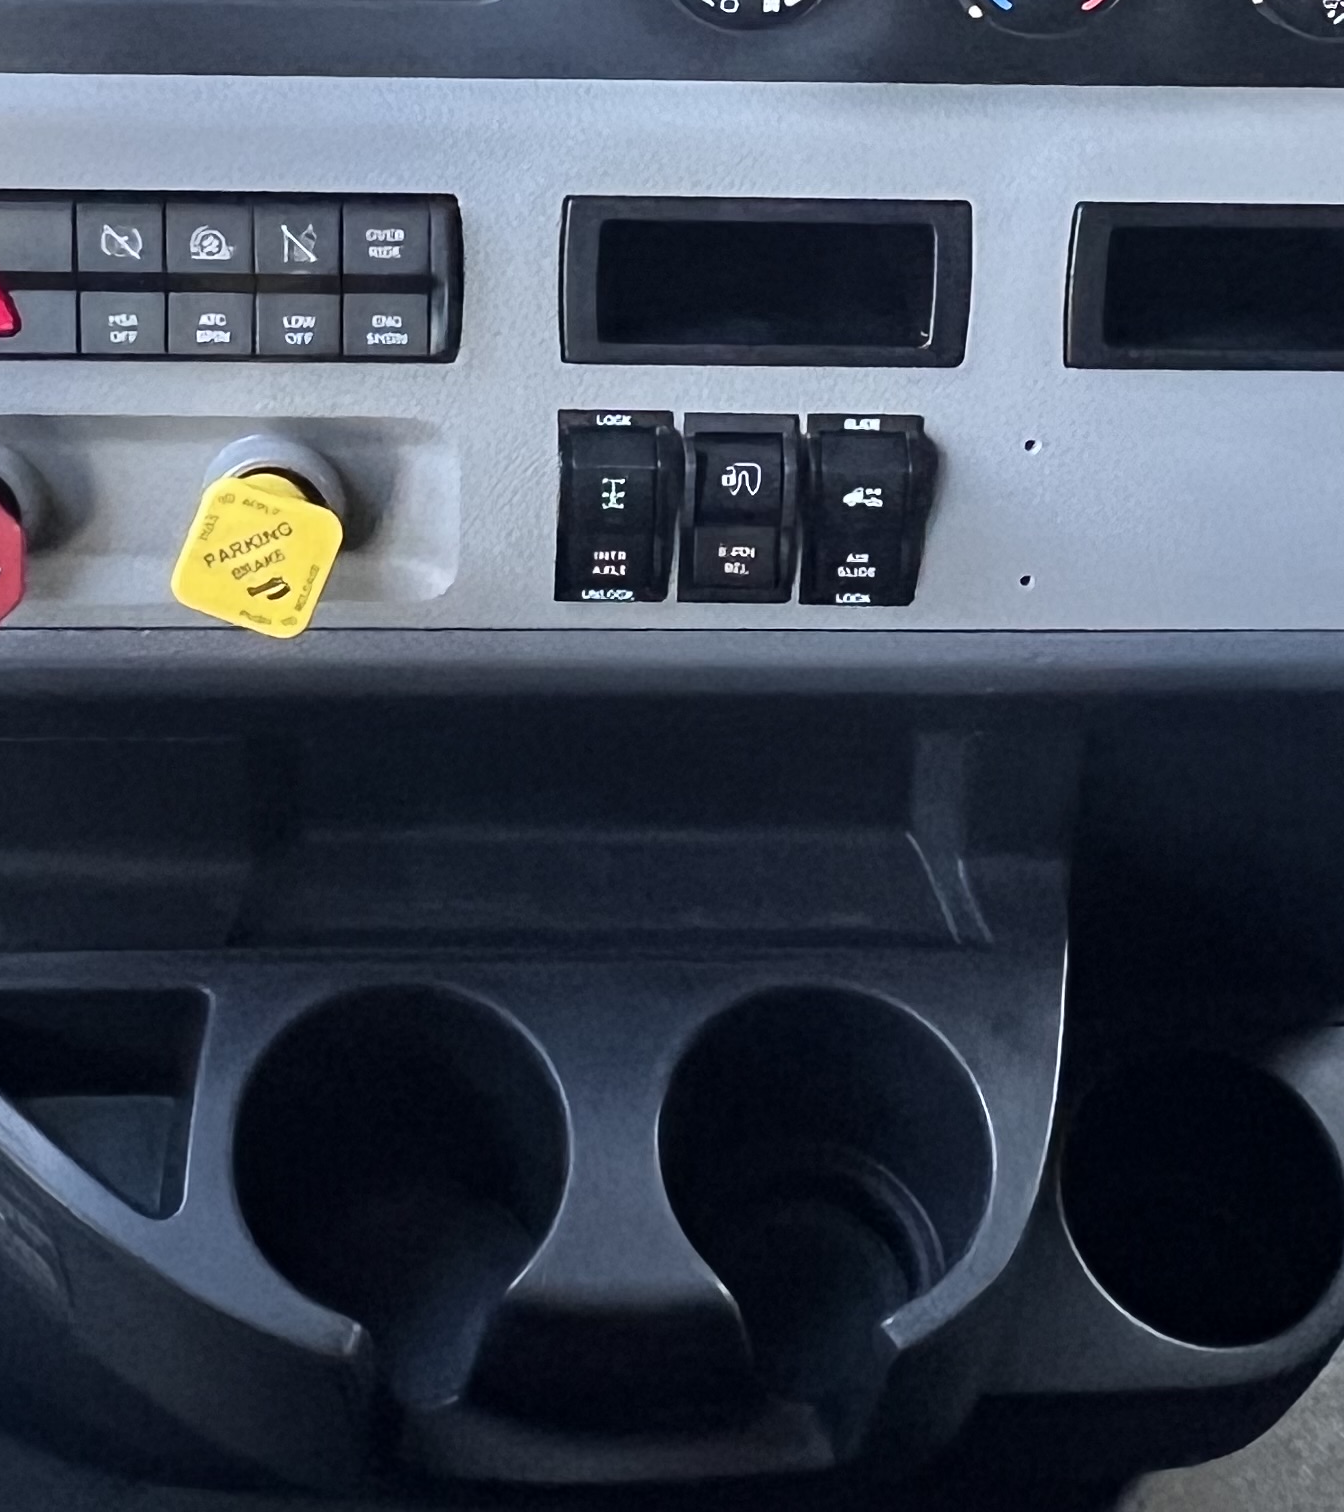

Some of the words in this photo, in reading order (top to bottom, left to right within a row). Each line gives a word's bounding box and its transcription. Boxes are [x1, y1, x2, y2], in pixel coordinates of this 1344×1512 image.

[285, 332, 314, 345] OFF
[596, 414, 632, 426] LOCK
[202, 521, 294, 568] PARKING
[835, 593, 871, 604] LOCK
